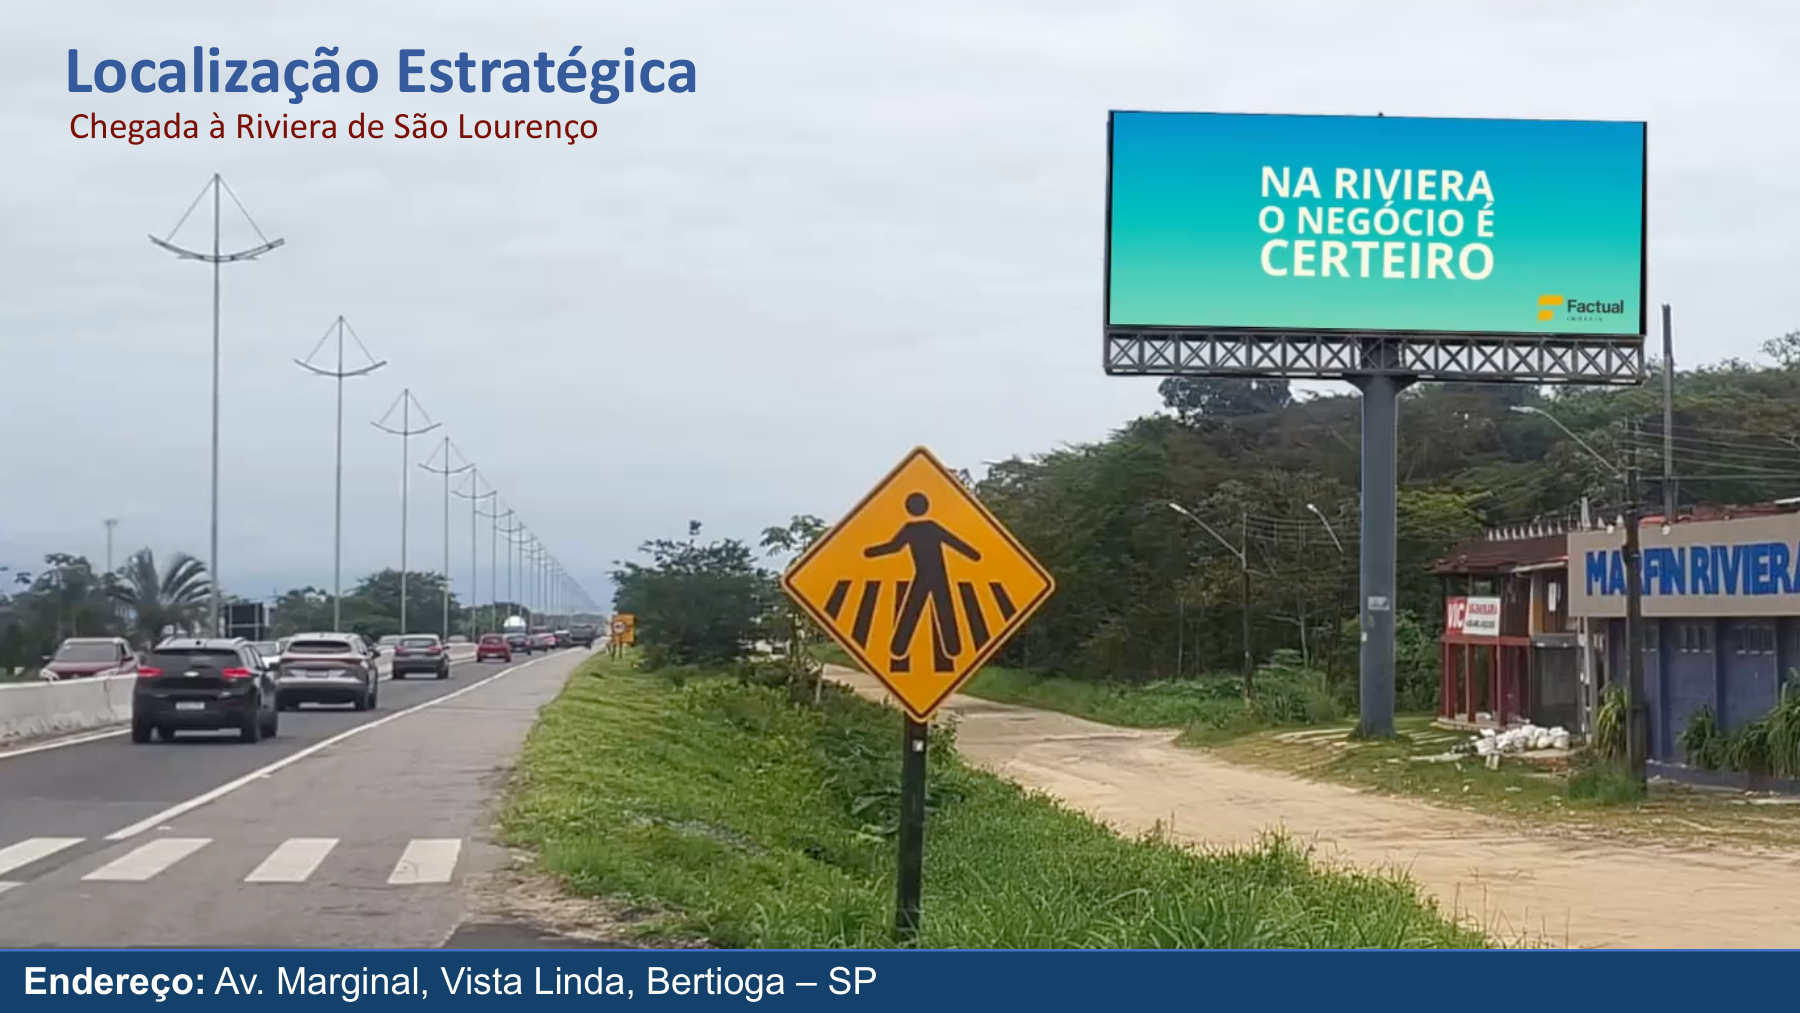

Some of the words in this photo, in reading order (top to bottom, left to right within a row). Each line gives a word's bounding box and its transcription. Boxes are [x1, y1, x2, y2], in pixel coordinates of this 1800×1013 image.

[1261, 166, 1322, 199] NA
[1335, 167, 1495, 203] RIVIERA
[1258, 205, 1285, 234] O
[1298, 201, 1465, 237] NEGÓCIO
[1477, 202, 1495, 238] É
[1260, 239, 1495, 280] CERTEIRO
[1567, 299, 1625, 315] Factual
[1586, 547, 1686, 597] MAFIN
